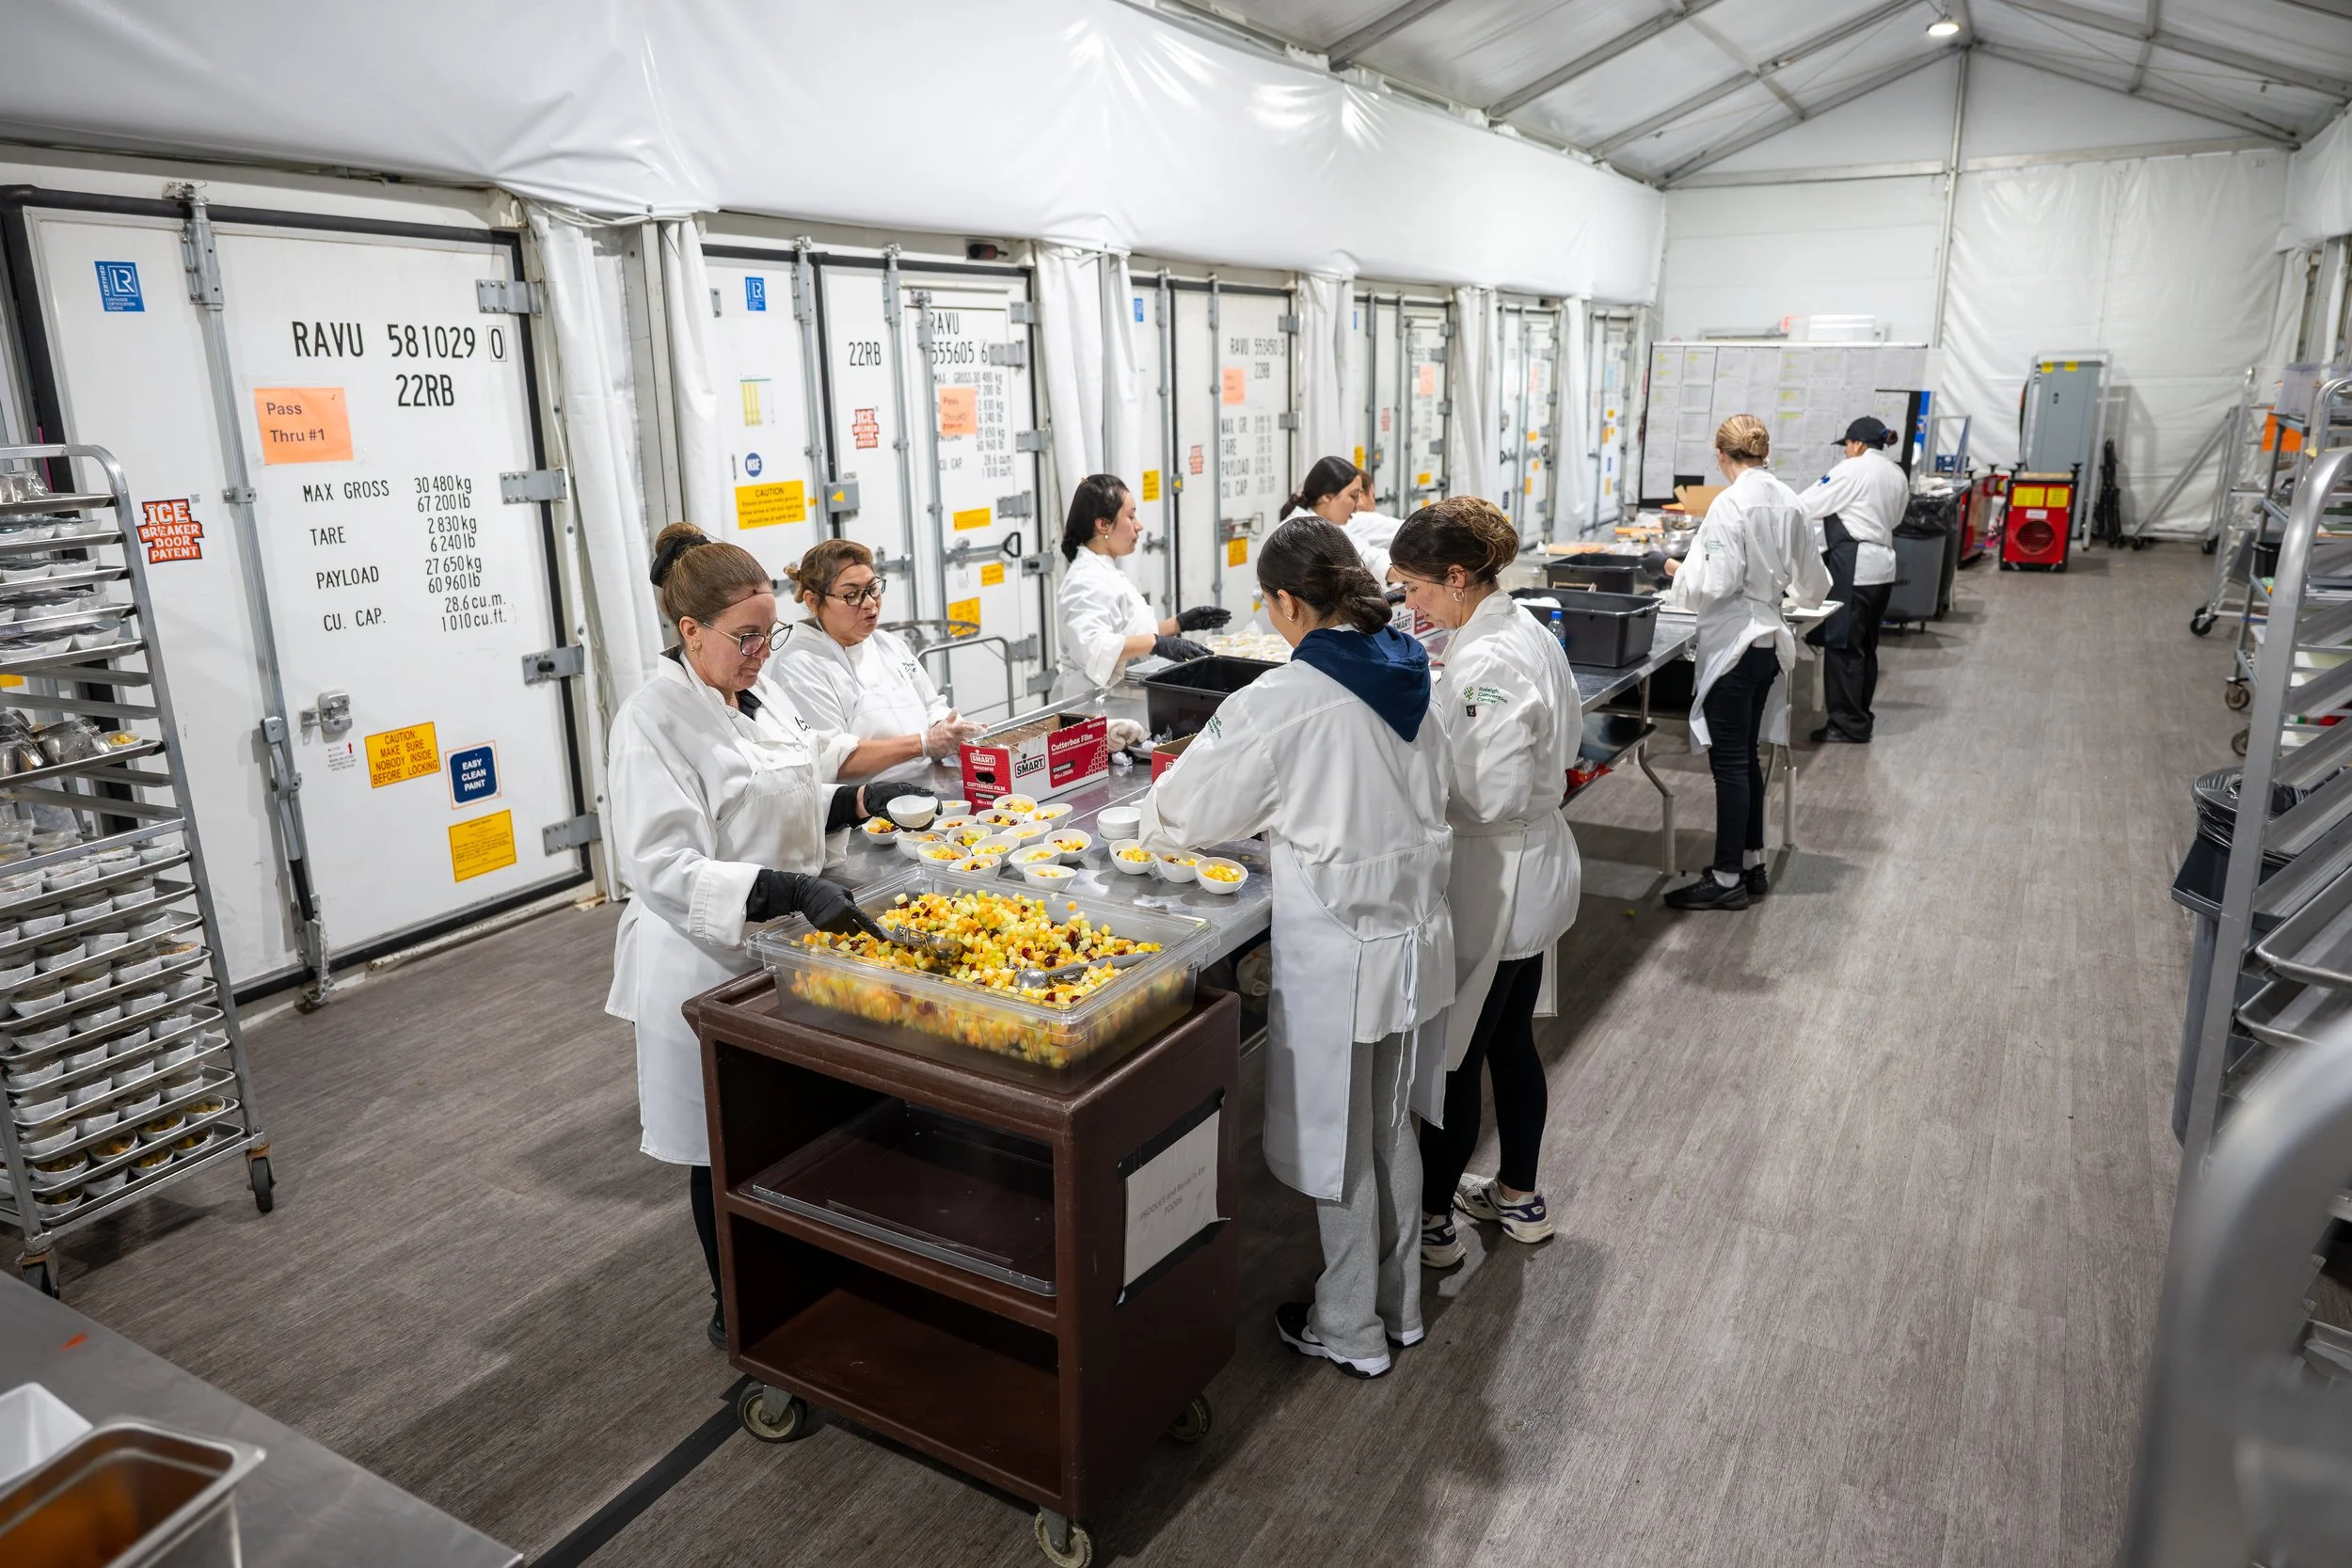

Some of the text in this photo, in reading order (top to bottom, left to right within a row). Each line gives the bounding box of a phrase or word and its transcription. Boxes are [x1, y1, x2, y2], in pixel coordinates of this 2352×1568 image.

[293, 321, 364, 357] RAVU
[388, 324, 476, 358] 581029
[849, 341, 882, 366] 22RB
[395, 374, 454, 407] 22RB
[266, 402, 303, 416] Pass
[270, 428, 326, 443] Thru #1
[746, 458, 761, 472] NSF
[303, 480, 389, 502] MAX GROSS
[146, 502, 188, 527] ICE
[141, 524, 199, 539] BREAKER
[310, 526, 346, 546] TARE
[154, 535, 191, 548] DOOR
[151, 546, 198, 562] PATENT
[316, 566, 380, 590] PAYLOAD
[323, 608, 387, 631] CU. CAP.
[1477, 691, 1508, 704] Convention
[1478, 686, 1499, 694] Raleigh
[380, 739, 424, 758] MAKE SURE
[1051, 734, 1093, 752] Cutterbox Film
[374, 755, 405, 771] NOBODY
[409, 749, 433, 763] INSIDE
[462, 758, 483, 770] EASY
[972, 755, 993, 764] SMART
[1017, 758, 1043, 775] SMART
[373, 759, 438, 785] BEFORE LOCKING
[461, 768, 486, 782] CLEAN
[464, 780, 486, 792] PAINT
